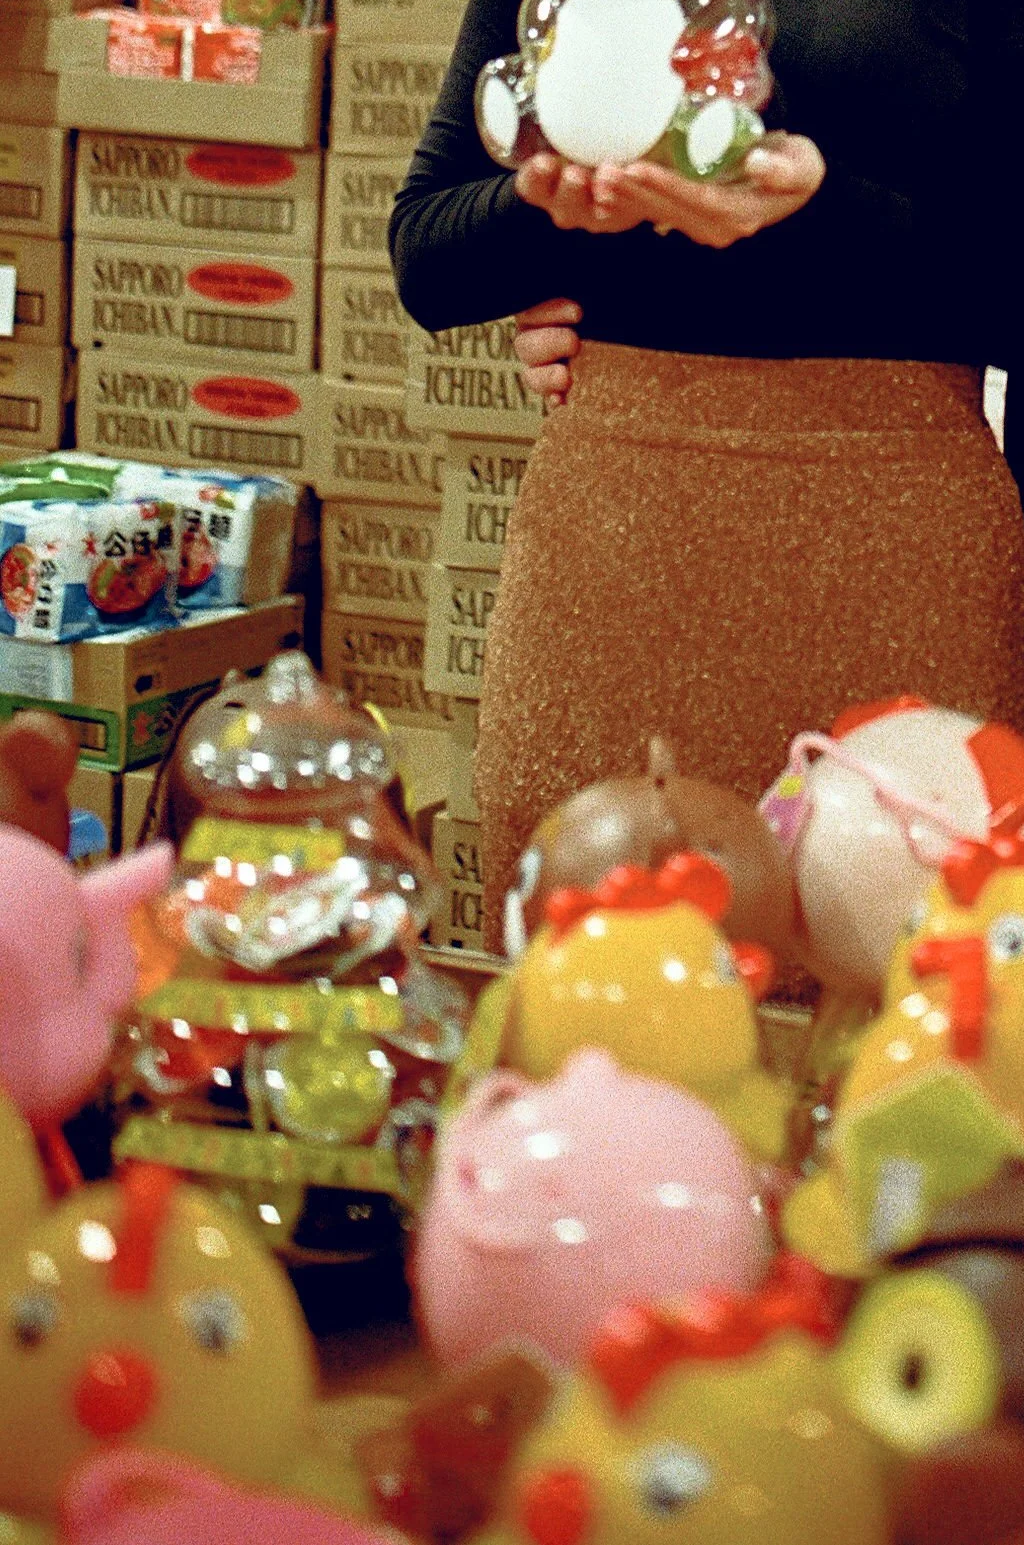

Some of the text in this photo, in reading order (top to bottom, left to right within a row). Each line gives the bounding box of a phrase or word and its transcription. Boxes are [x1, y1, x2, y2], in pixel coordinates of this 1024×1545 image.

[350, 59, 446, 94] SAPPOR
[90, 142, 182, 180] SAPPORO
[89, 181, 175, 219] ICHIBAN
[92, 259, 184, 298] SAPPORO
[93, 298, 181, 338] ICHIBAN
[426, 322, 518, 361] SAPPOR
[98, 371, 189, 413] SAPPORO
[97, 411, 184, 452] ICHIBAN
[334, 443, 428, 486] ICHIBAN
[468, 455, 528, 495] SAPP
[335, 515, 433, 561] SAPPORO
[334, 562, 430, 603] ICHIBAN
[343, 628, 425, 669] SAPPOR
